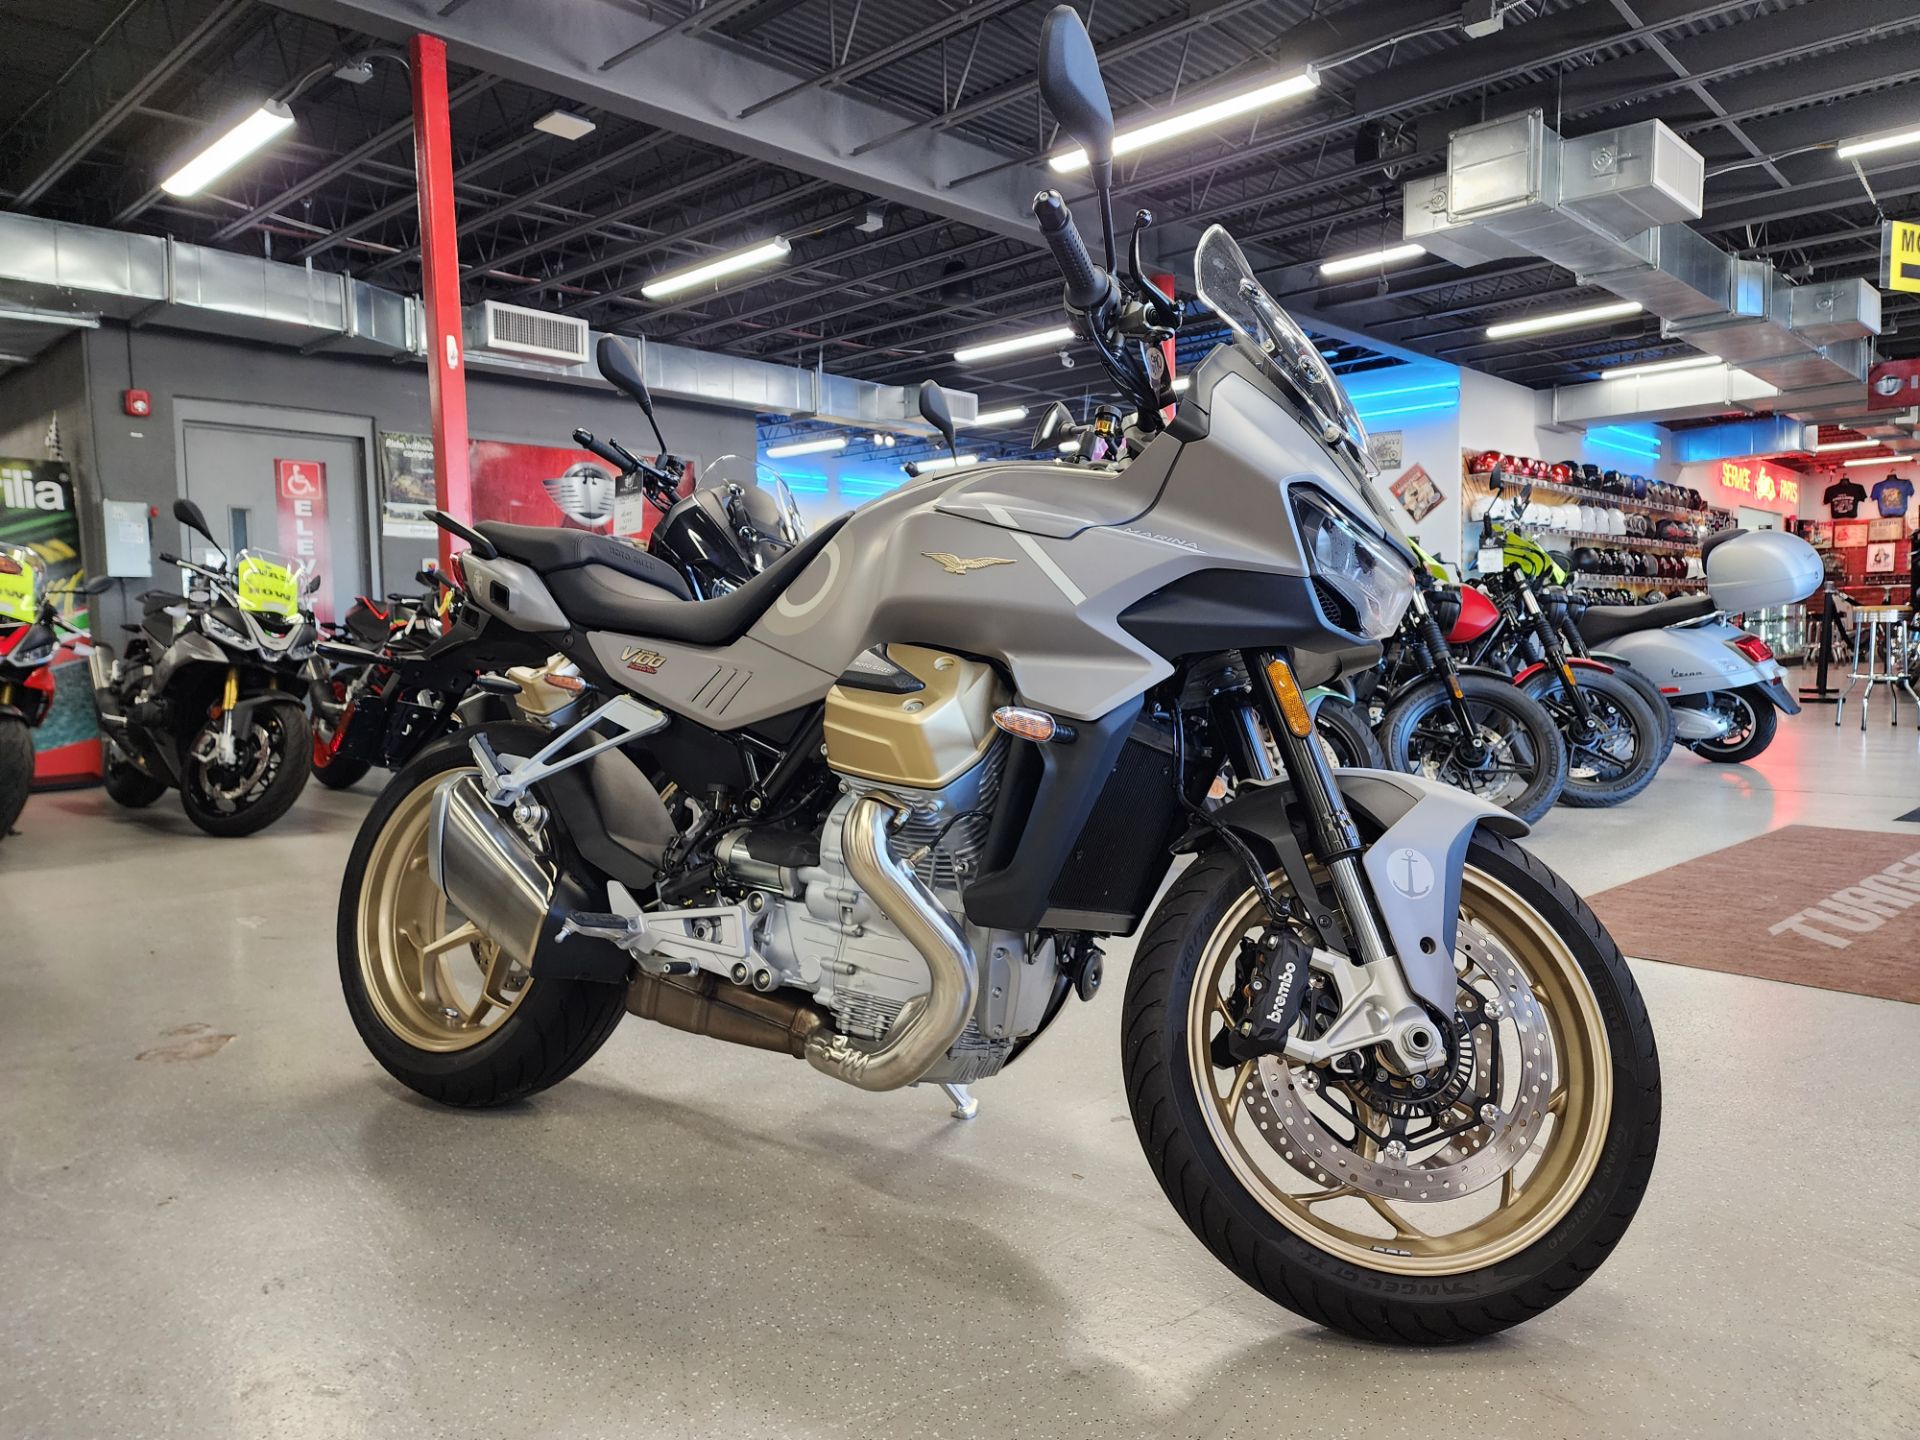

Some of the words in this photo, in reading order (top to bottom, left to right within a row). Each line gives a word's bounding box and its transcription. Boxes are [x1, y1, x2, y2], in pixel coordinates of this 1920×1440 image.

[403, 450, 433, 460] compro
[405, 440, 433, 451] withou
[0, 468, 65, 511] ilia
[1722, 461, 1751, 492] SERVICE
[1780, 479, 1798, 504] PARTS
[1124, 527, 1199, 549] MARINA
[620, 645, 666, 667] V100
[1266, 961, 1296, 1024] brembo
